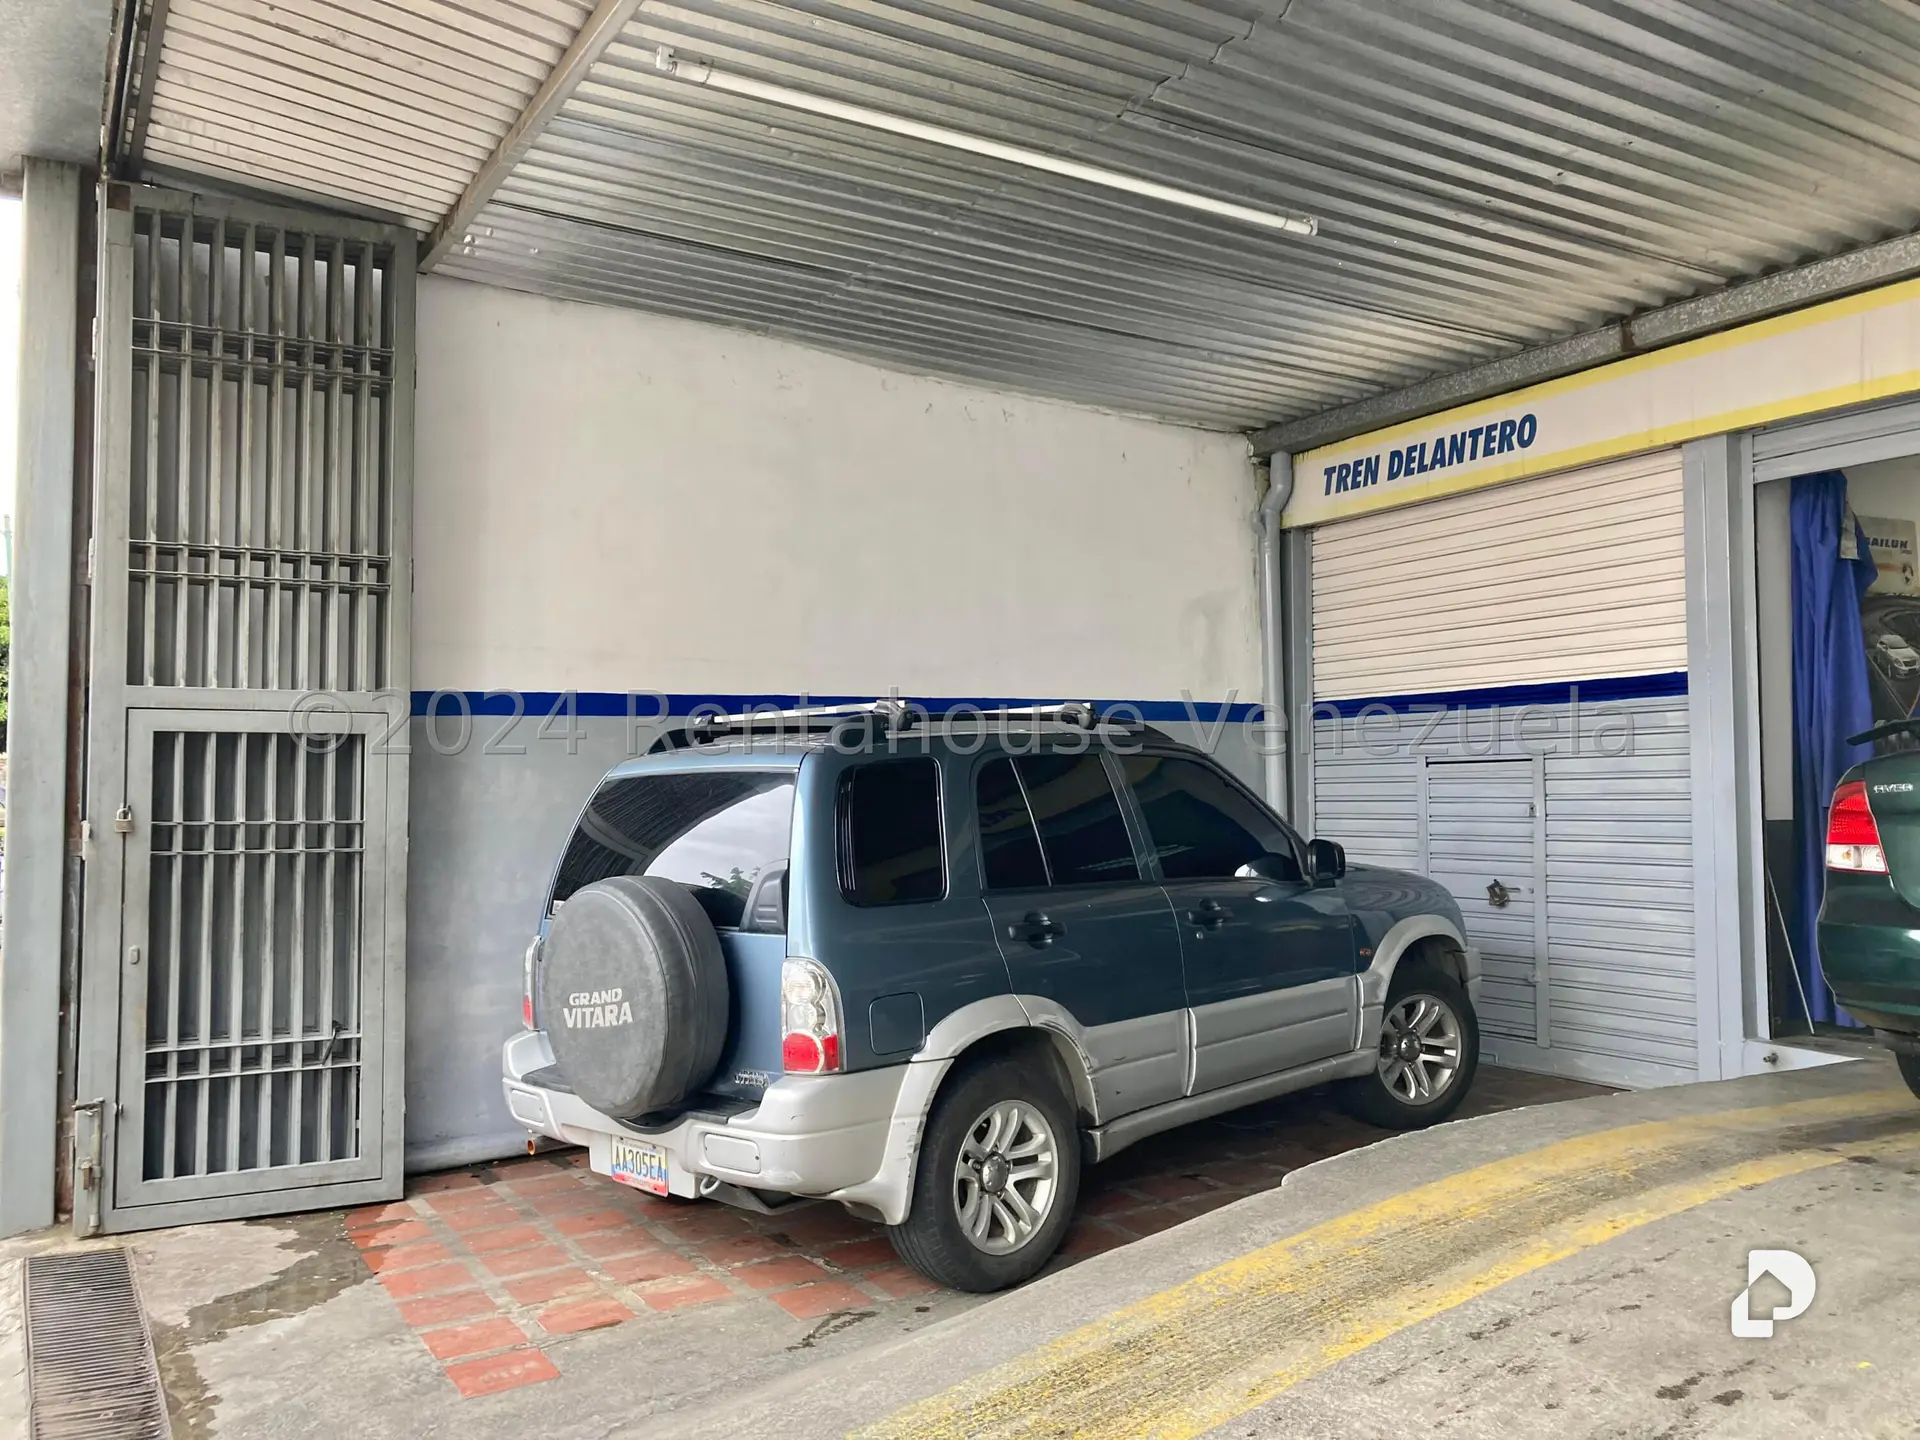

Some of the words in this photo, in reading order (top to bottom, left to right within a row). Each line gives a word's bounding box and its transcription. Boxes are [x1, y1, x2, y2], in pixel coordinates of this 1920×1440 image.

[1324, 455, 1380, 496] TREN
[1387, 413, 1537, 482] DELANTERO
[569, 988, 622, 1005] GRAND
[563, 1001, 633, 1028] VITARA
[615, 1145, 663, 1182] AA305EA
